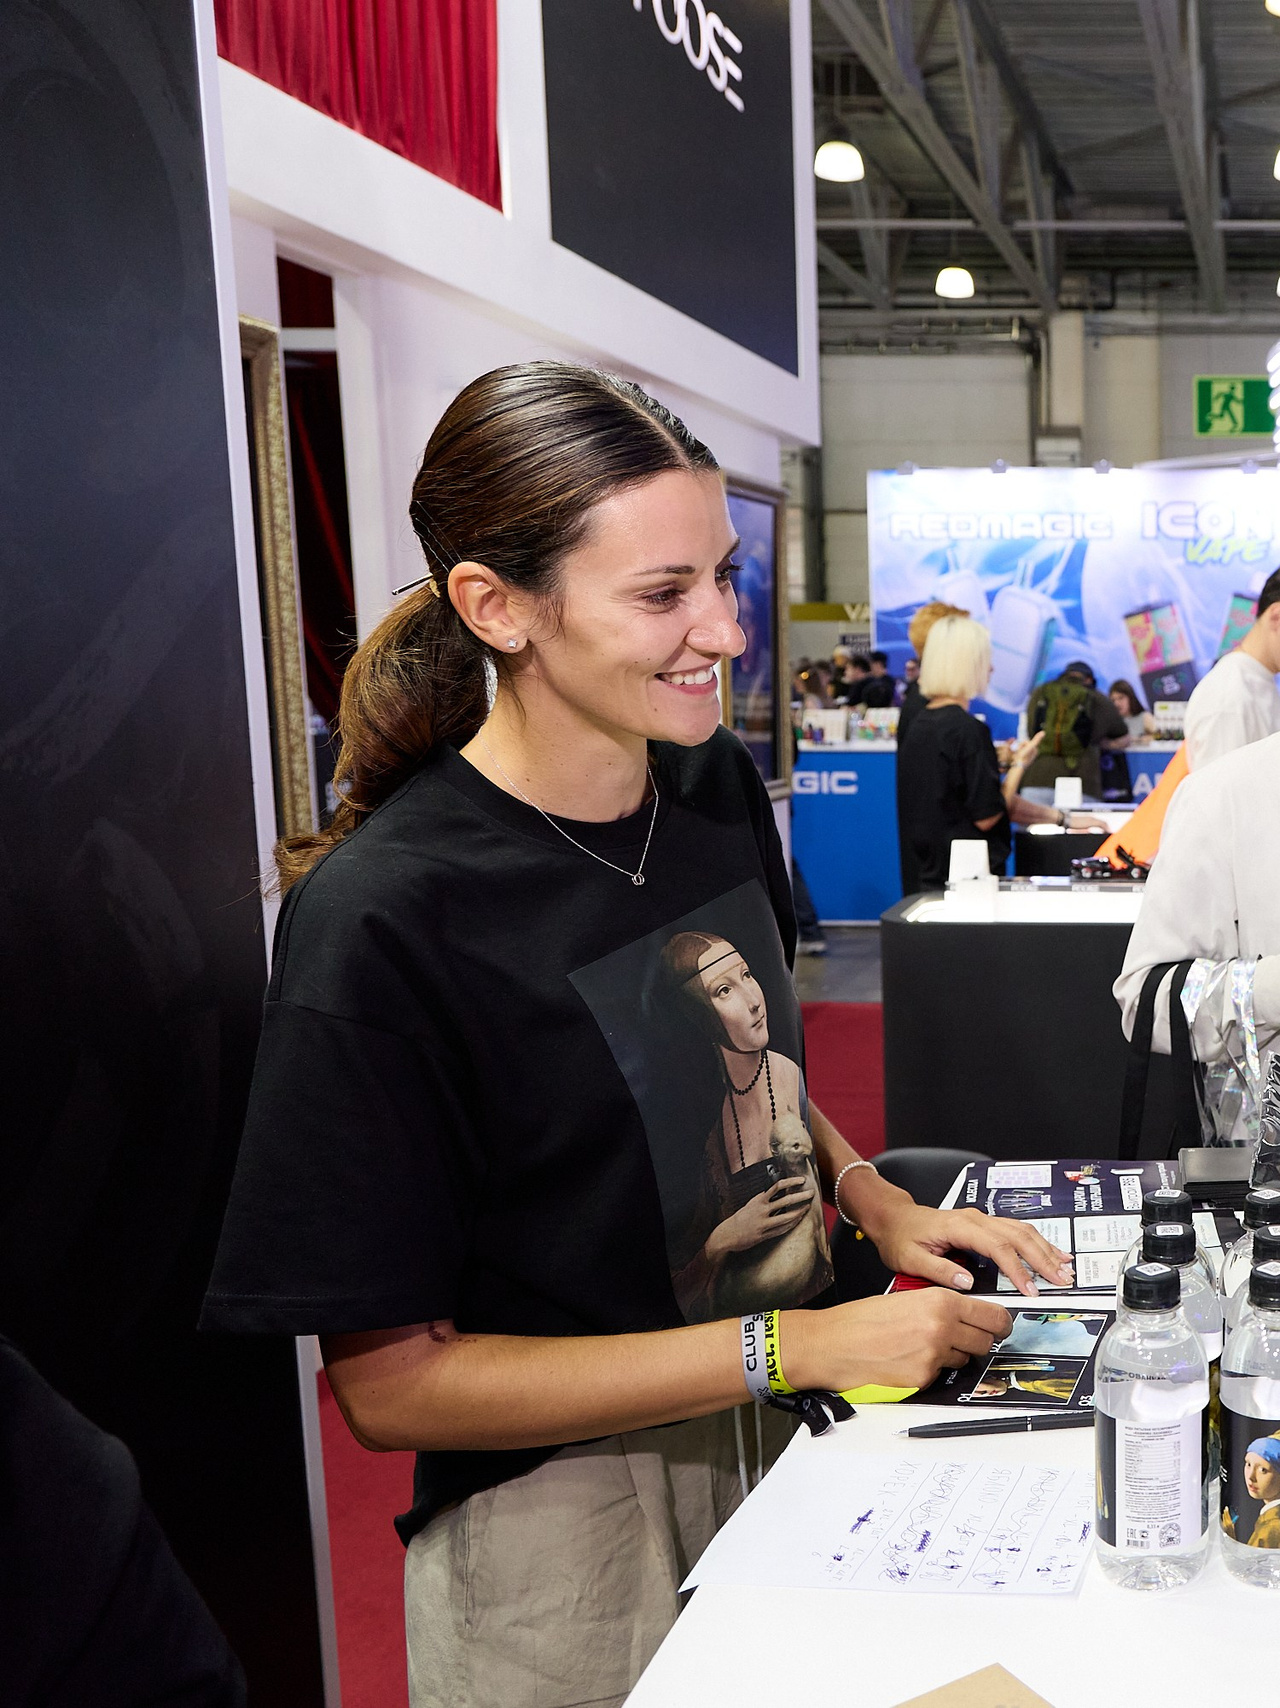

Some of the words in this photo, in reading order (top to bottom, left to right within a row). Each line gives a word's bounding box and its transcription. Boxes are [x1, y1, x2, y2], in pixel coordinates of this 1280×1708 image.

[1141, 501, 1273, 541] ICON
[1185, 536, 1270, 565] VAPE
[744, 1321, 758, 1372] CLUB
